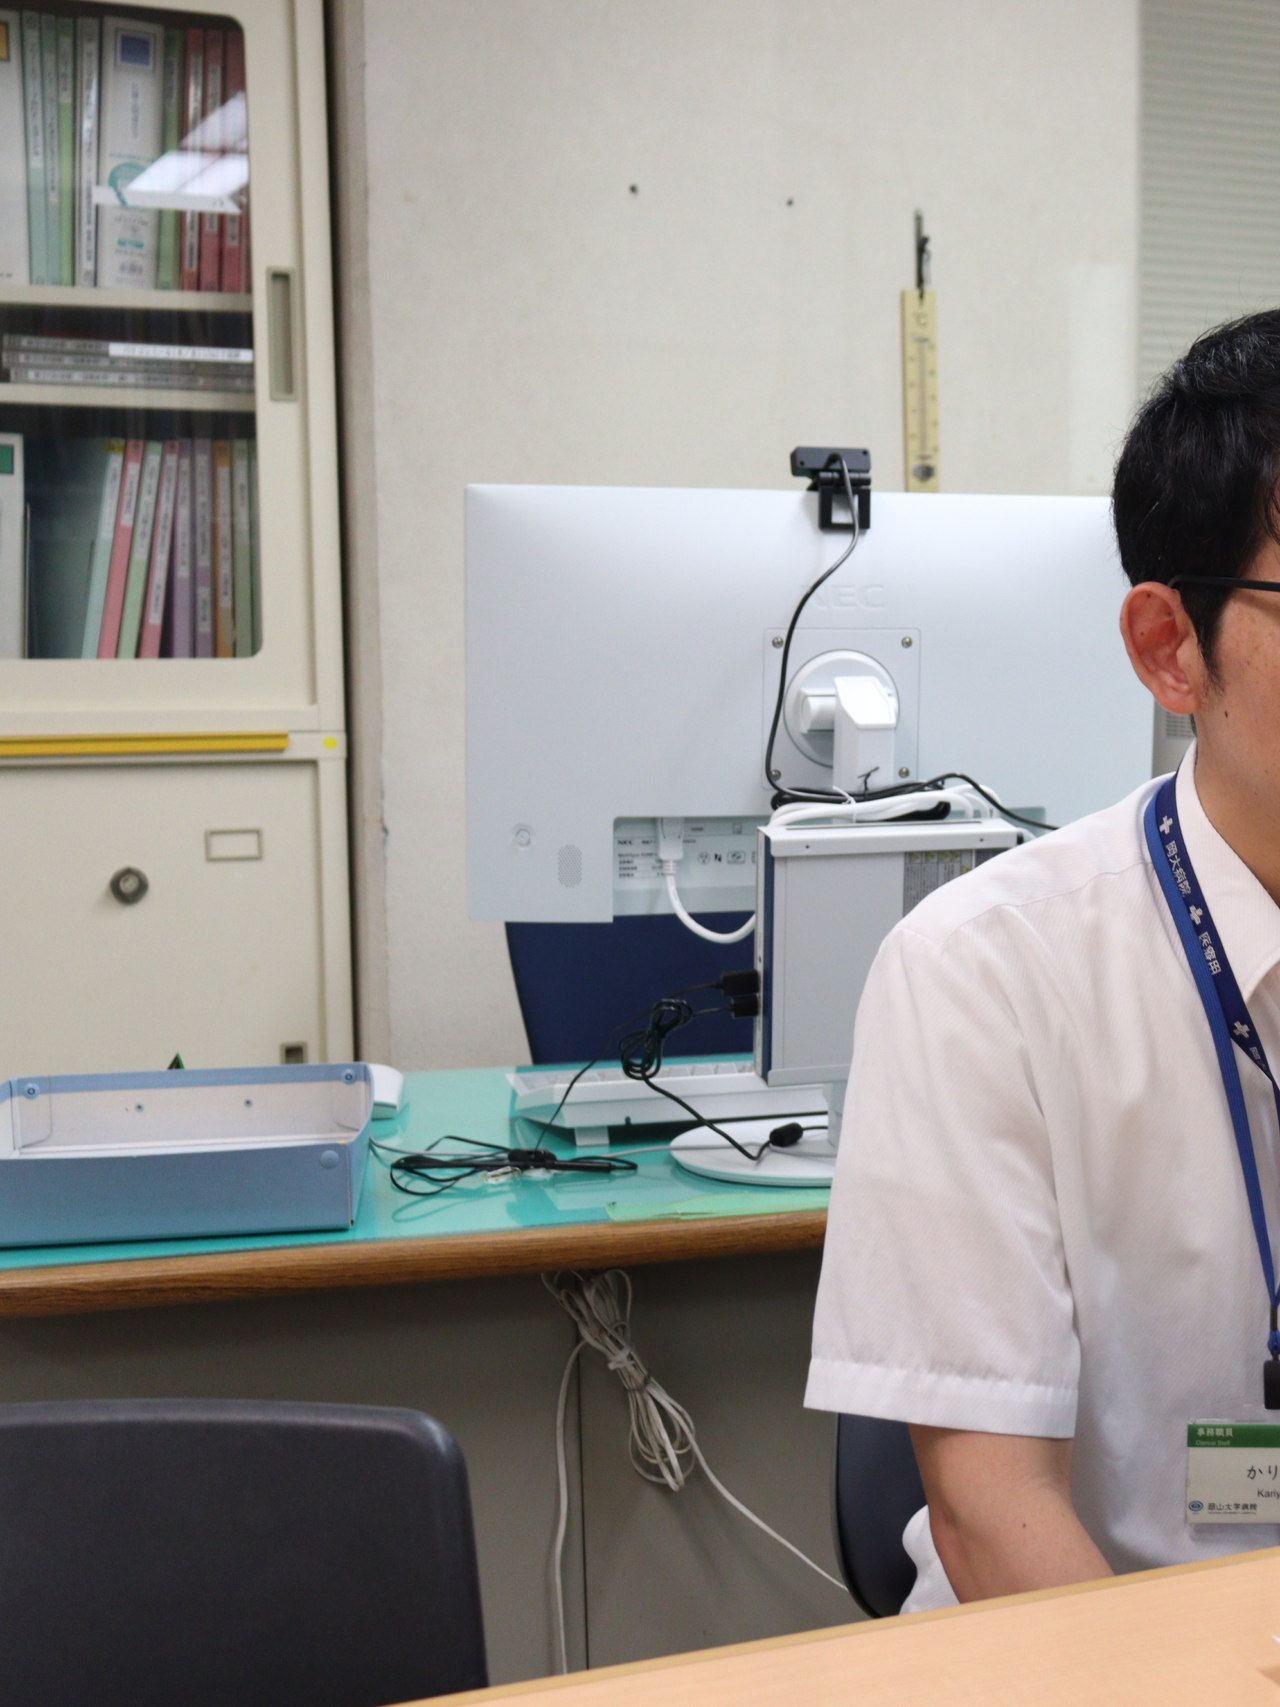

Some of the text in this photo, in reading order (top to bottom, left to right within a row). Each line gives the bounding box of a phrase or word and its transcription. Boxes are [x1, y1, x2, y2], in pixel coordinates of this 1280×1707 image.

[1197, 1427, 1234, 1438] 事務職員
[1208, 1502, 1258, 1511] 岡山大学病院
